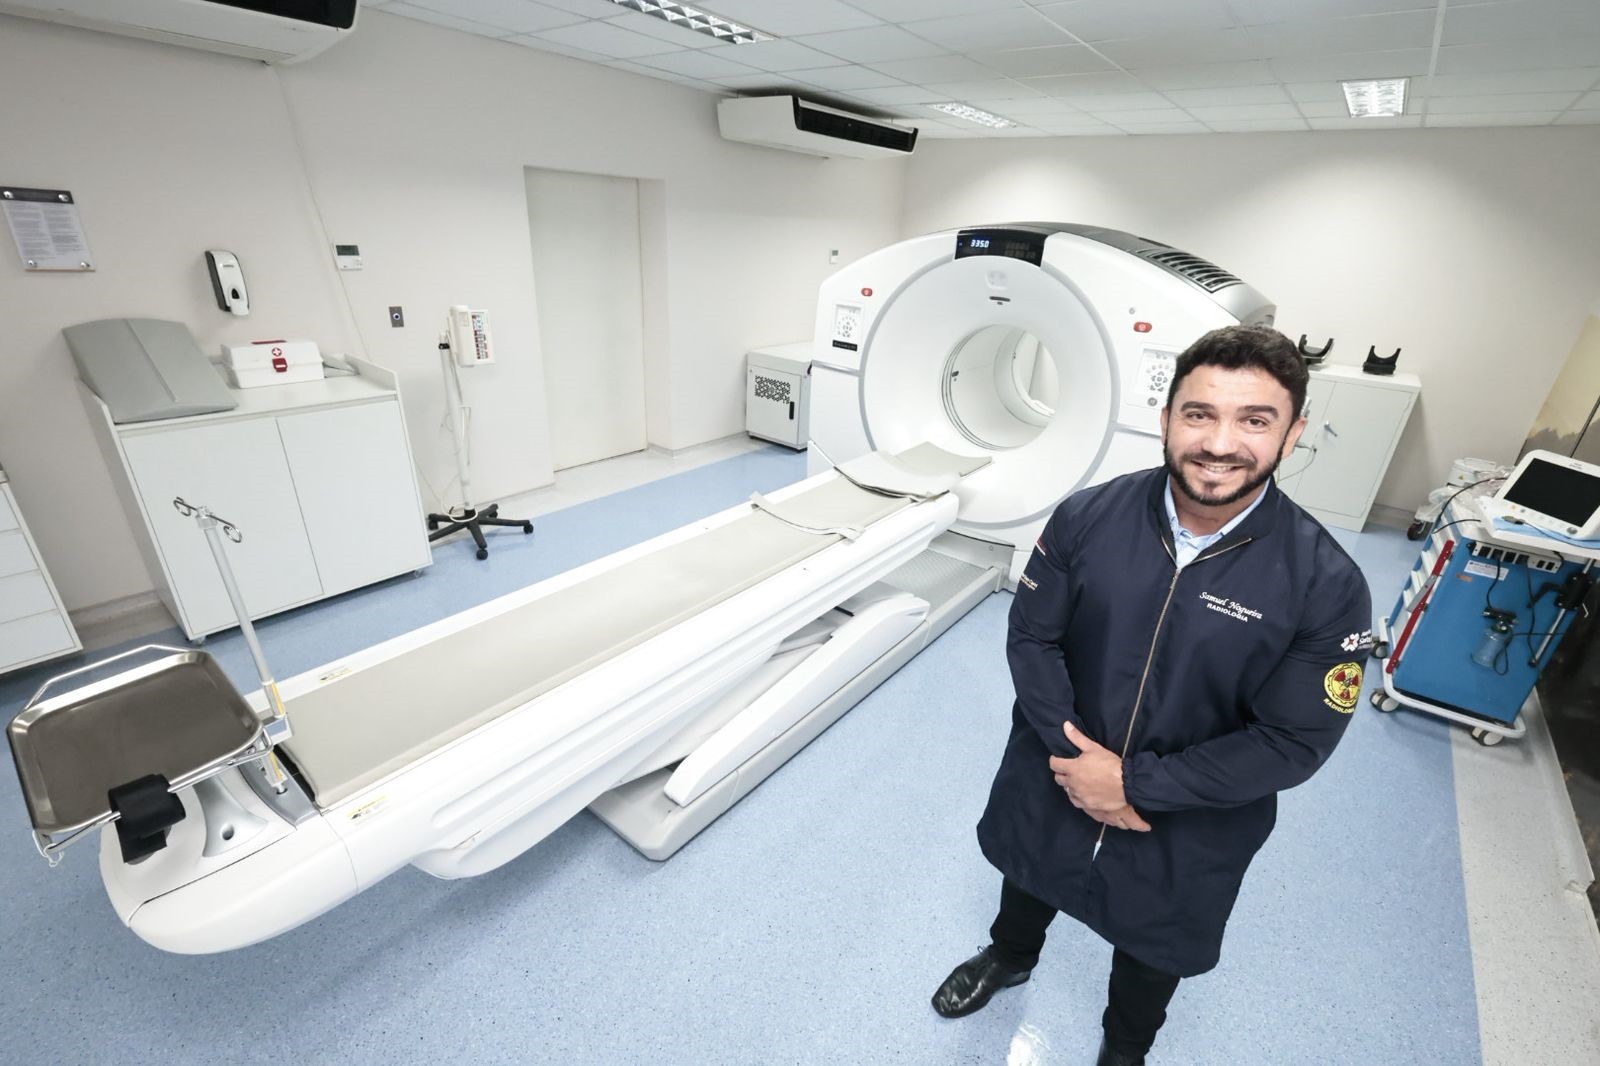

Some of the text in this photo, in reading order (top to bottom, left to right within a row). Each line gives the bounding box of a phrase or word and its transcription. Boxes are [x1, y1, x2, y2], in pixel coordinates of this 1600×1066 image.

[1199, 591, 1263, 619] Samuel Nogueira
[1206, 602, 1248, 622] RADIOLOGIA
